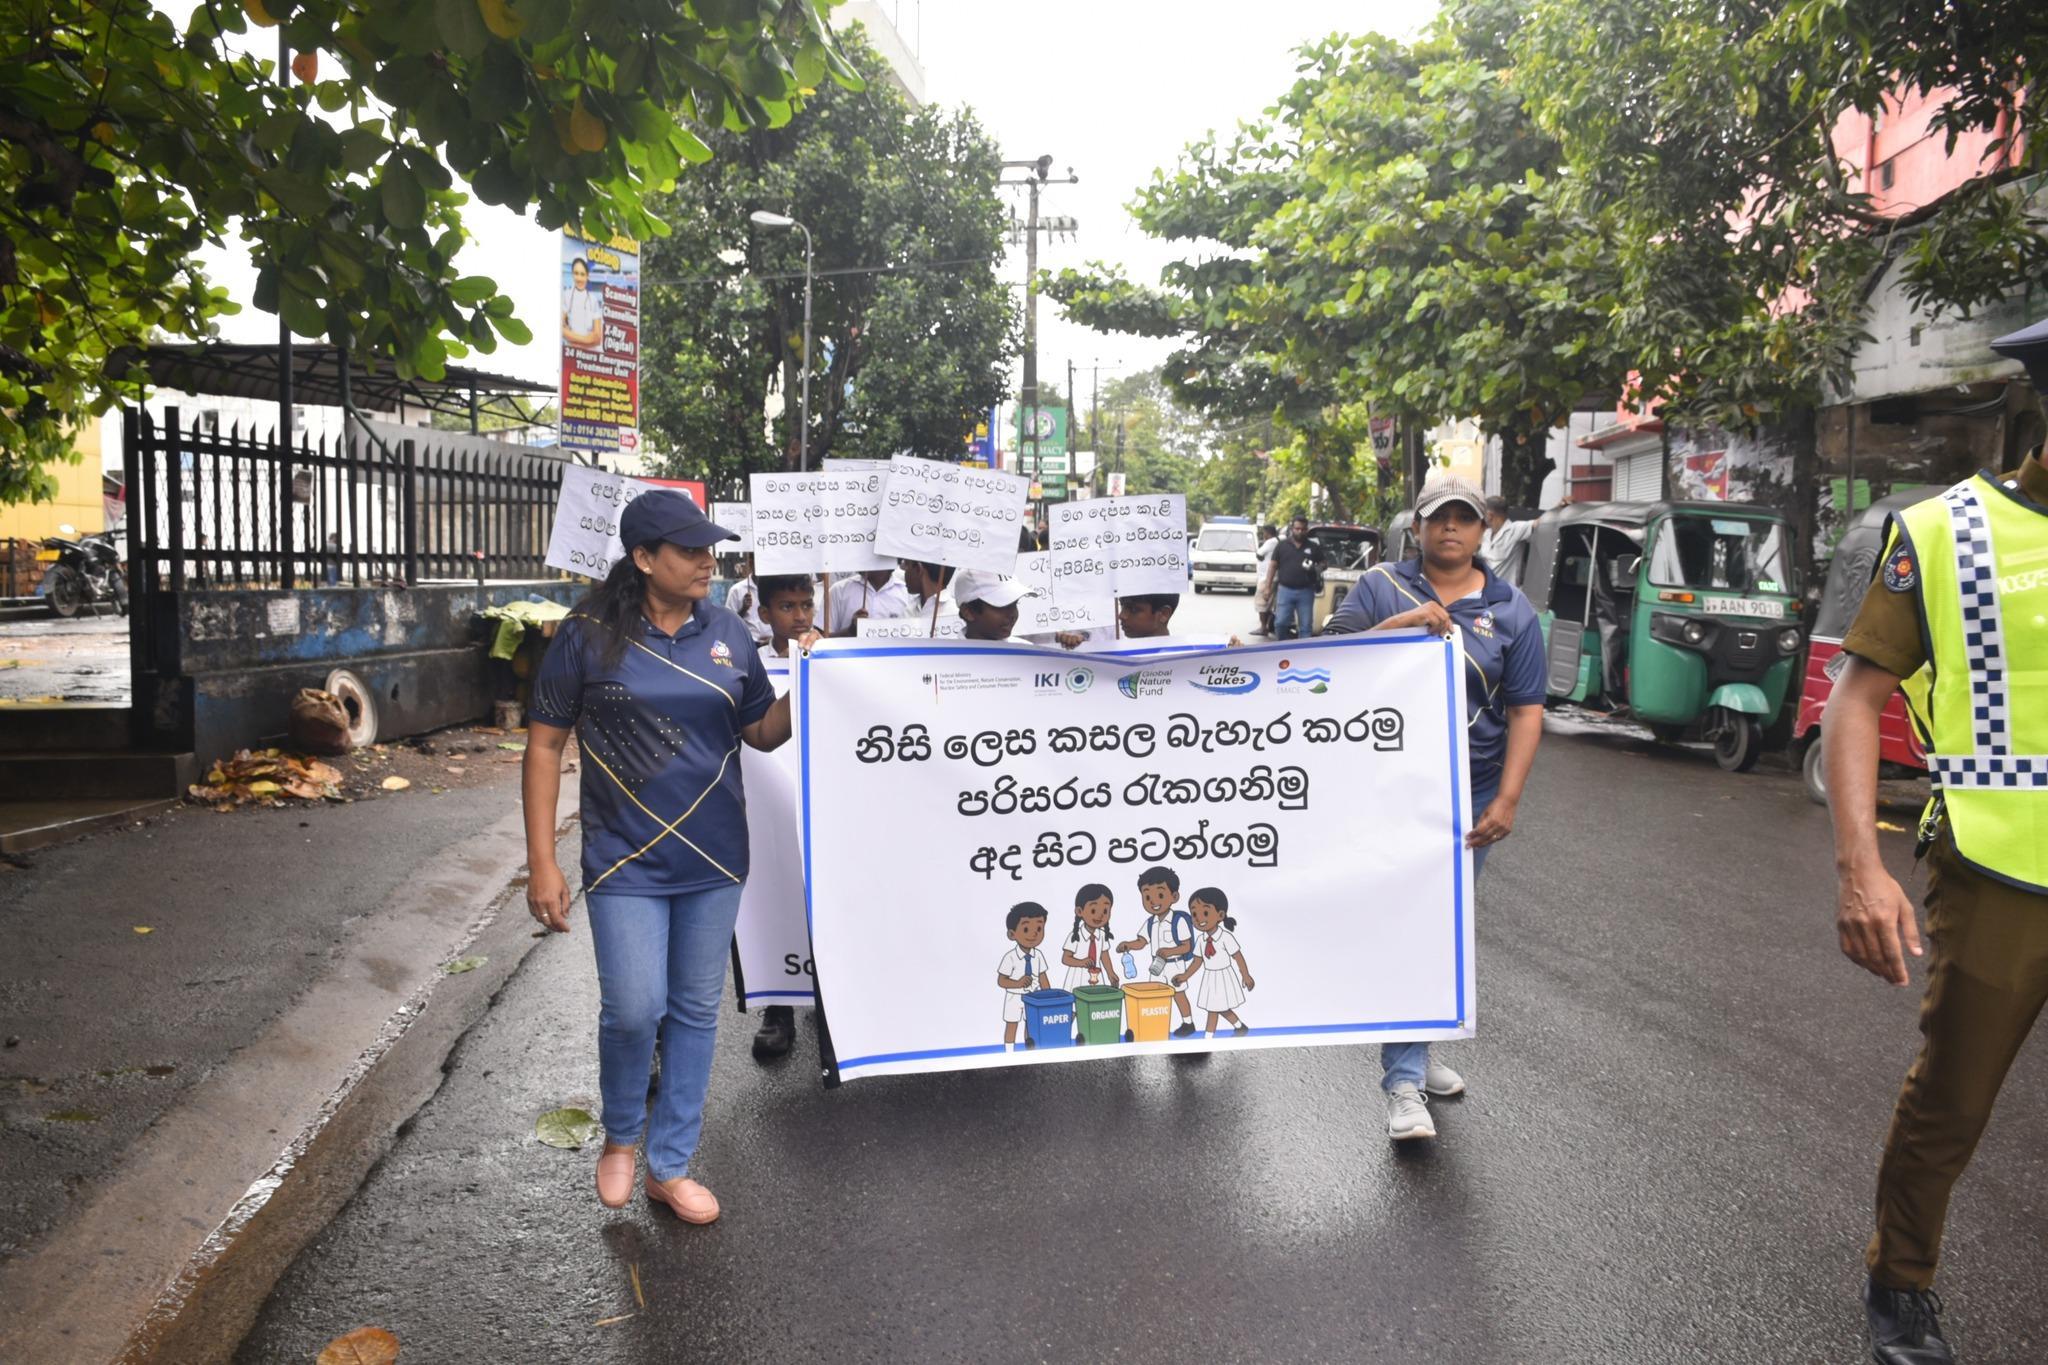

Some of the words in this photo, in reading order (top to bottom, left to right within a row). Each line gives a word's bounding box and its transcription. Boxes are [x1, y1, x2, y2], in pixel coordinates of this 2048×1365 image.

[605, 286, 637, 307] Scanning
[565, 347, 574, 357] 24
[576, 350, 598, 362] Hours
[599, 354, 636, 371] Emergency
[576, 361, 613, 376] Treatment
[614, 368, 629, 378] Unit
[765, 480, 791, 493] මග
[796, 480, 839, 496] දෙපස
[756, 509, 798, 522] කසළ
[803, 505, 829, 522] දමා
[834, 503, 880, 518] පරිසර
[1061, 509, 1083, 522] මග
[817, 529, 876, 544] නොකර
[1053, 536, 1090, 551] කසළ
[1095, 531, 1121, 545] දමා
[1126, 527, 1183, 542] පරිසරය
[1720, 600, 1746, 614] AAN
[1142, 669, 1173, 677] Global
[1199, 664, 1240, 676] Living
[1034, 673, 1060, 687] IKI
[1140, 677, 1172, 686] Nature
[1207, 675, 1247, 686] Lakes
[1139, 687, 1163, 696] Fund
[856, 724, 932, 763] නිසි
[944, 729, 1037, 767] ලෙස
[1048, 724, 1156, 758] කසල
[1167, 711, 1291, 753] බැහැර
[1303, 707, 1405, 752] කරමු
[957, 775, 1112, 816] පරිසරය
[1123, 765, 1309, 811] රැකගනිමු
[969, 845, 1022, 881] අද
[1032, 831, 1097, 868] සිට
[1108, 819, 1279, 868] පටන්ගමු
[1091, 1009, 1120, 1021] ORGANIC
[1141, 1006, 1169, 1016] PLASTIC
[1042, 1014, 1069, 1025] PAPER
